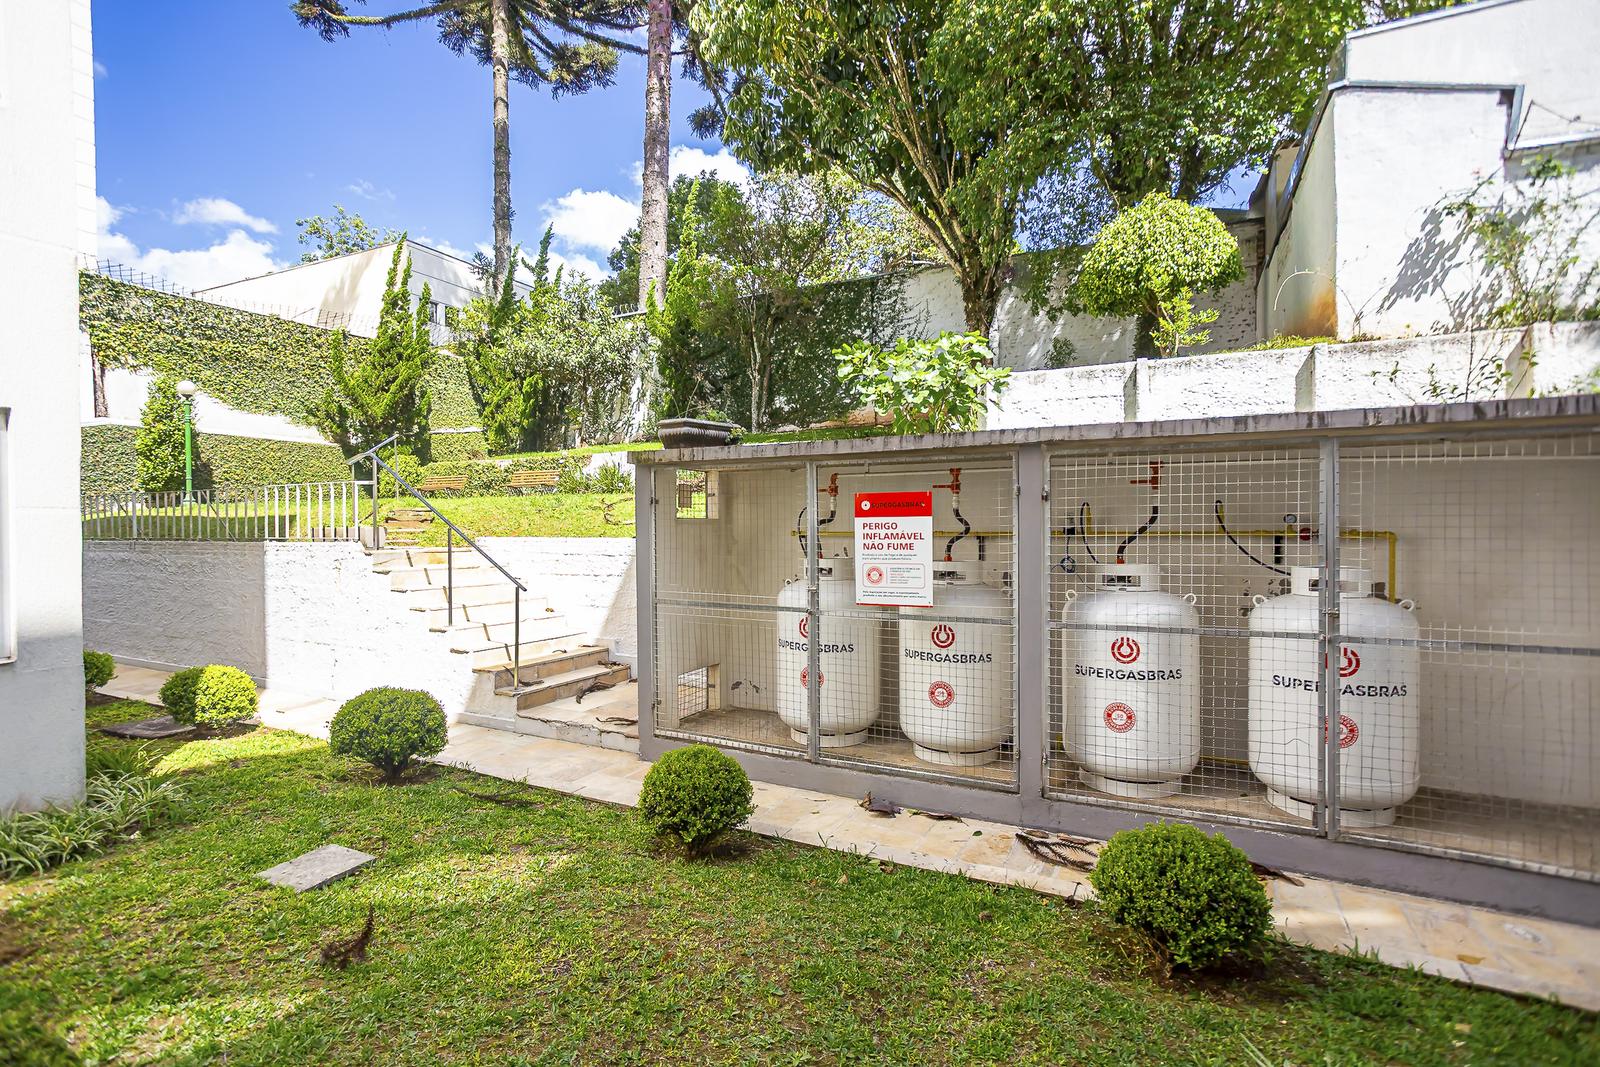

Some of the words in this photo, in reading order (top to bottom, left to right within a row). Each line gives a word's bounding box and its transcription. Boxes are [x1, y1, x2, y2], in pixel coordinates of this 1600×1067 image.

[862, 522, 898, 530] PERIGO
[862, 530, 925, 540] INFLAMÁVEL
[862, 541, 884, 551] NÃO
[887, 543, 915, 551] FUME
[778, 638, 855, 653] SUPERGSBRAS
[904, 648, 992, 664] SUPERGASBRAS
[1075, 664, 1183, 681] SUPERGASBRAS
[1272, 674, 1407, 697] SUPEASBRAS
